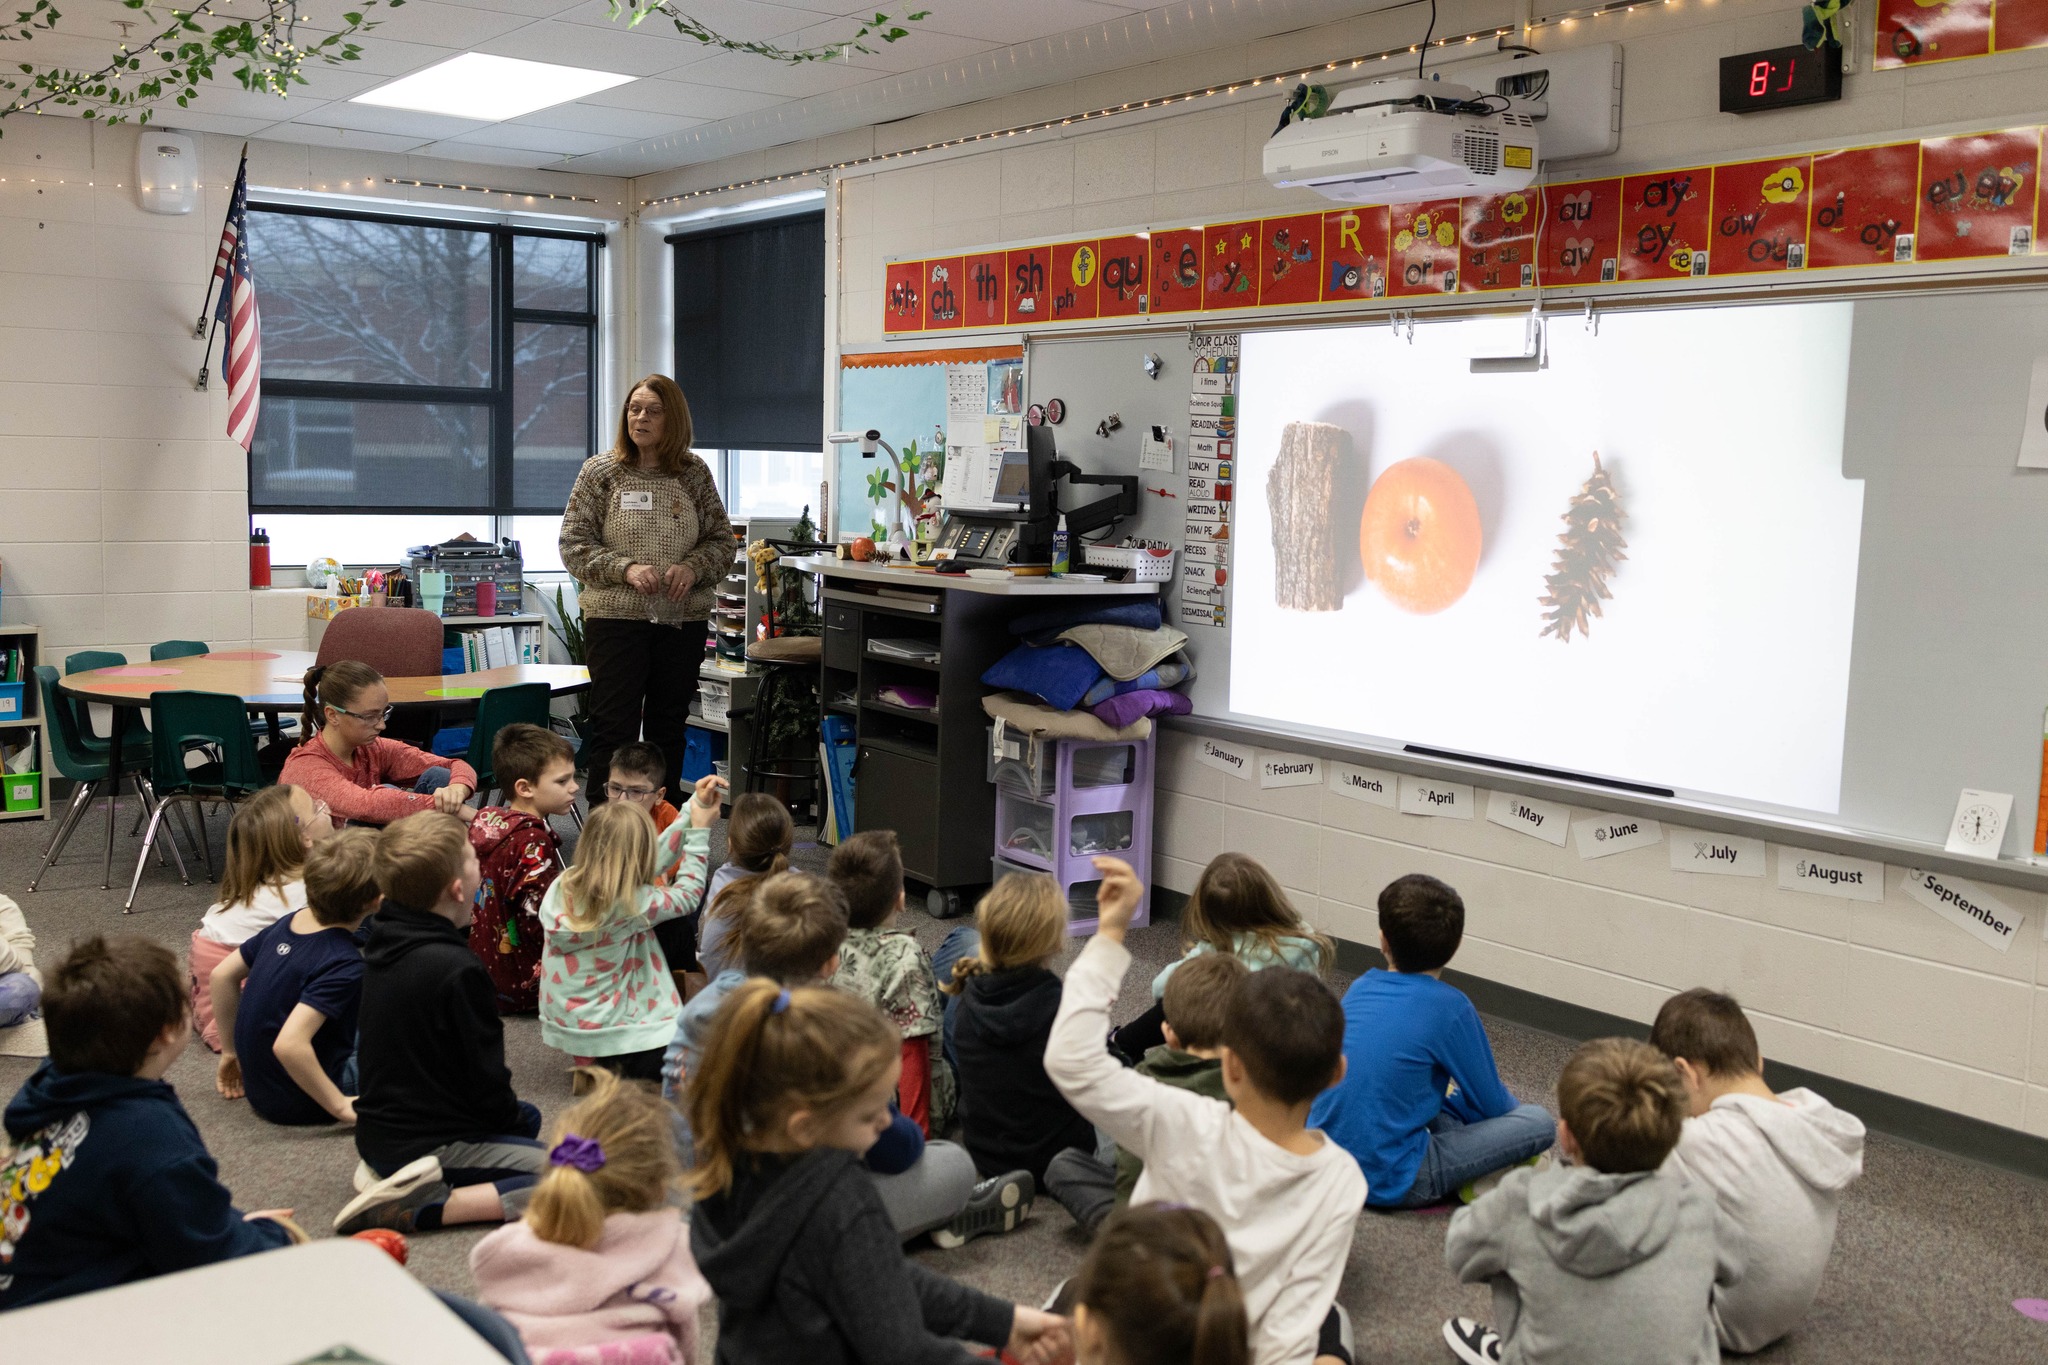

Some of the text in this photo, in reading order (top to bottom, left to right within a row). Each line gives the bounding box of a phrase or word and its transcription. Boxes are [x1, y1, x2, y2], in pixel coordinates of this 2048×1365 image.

[1321, 149, 1339, 157] EPSON
[1644, 176, 1693, 217] ay
[1559, 200, 1593, 222] au
[1720, 212, 1761, 236] ow
[1340, 214, 1366, 260] R
[1636, 222, 1676, 263] ey
[1163, 251, 1171, 263] e
[1560, 244, 1594, 267] aw
[1748, 236, 1792, 262] ou
[975, 263, 998, 301] th
[1016, 253, 1044, 294] sh
[1103, 256, 1144, 301] qu
[1405, 261, 1433, 286] or
[892, 280, 916, 309] wh
[1161, 280, 1170, 292] o
[931, 281, 955, 316] ch
[1056, 288, 1074, 316] ph
[1154, 296, 1161, 307] u
[1196, 335, 1238, 348] OUR CLASS
[1195, 345, 1239, 359] SCHEDULE
[1189, 400, 1210, 408] Science
[1191, 420, 1219, 430] READING
[1197, 443, 1213, 452] Math
[1188, 461, 1210, 472] LUNCH
[1189, 479, 1206, 489] READ
[1189, 489, 1210, 498] ALOUD
[1187, 504, 1217, 516] WRITING
[1186, 525, 1213, 536] GYM/ PE
[1184, 544, 1207, 556] RECESS
[1184, 566, 1206, 577] SNACK
[1186, 585, 1211, 597] Science
[1181, 607, 1213, 619] DISMISSAL
[1210, 745, 1244, 768] January
[1273, 762, 1314, 776] February
[1352, 775, 1383, 793] March
[1428, 790, 1455, 806] April
[1518, 805, 1544, 826] May
[1609, 822, 1639, 839] June
[1709, 845, 1738, 863] July
[1808, 863, 1863, 885] August
[1923, 875, 2013, 937] September
